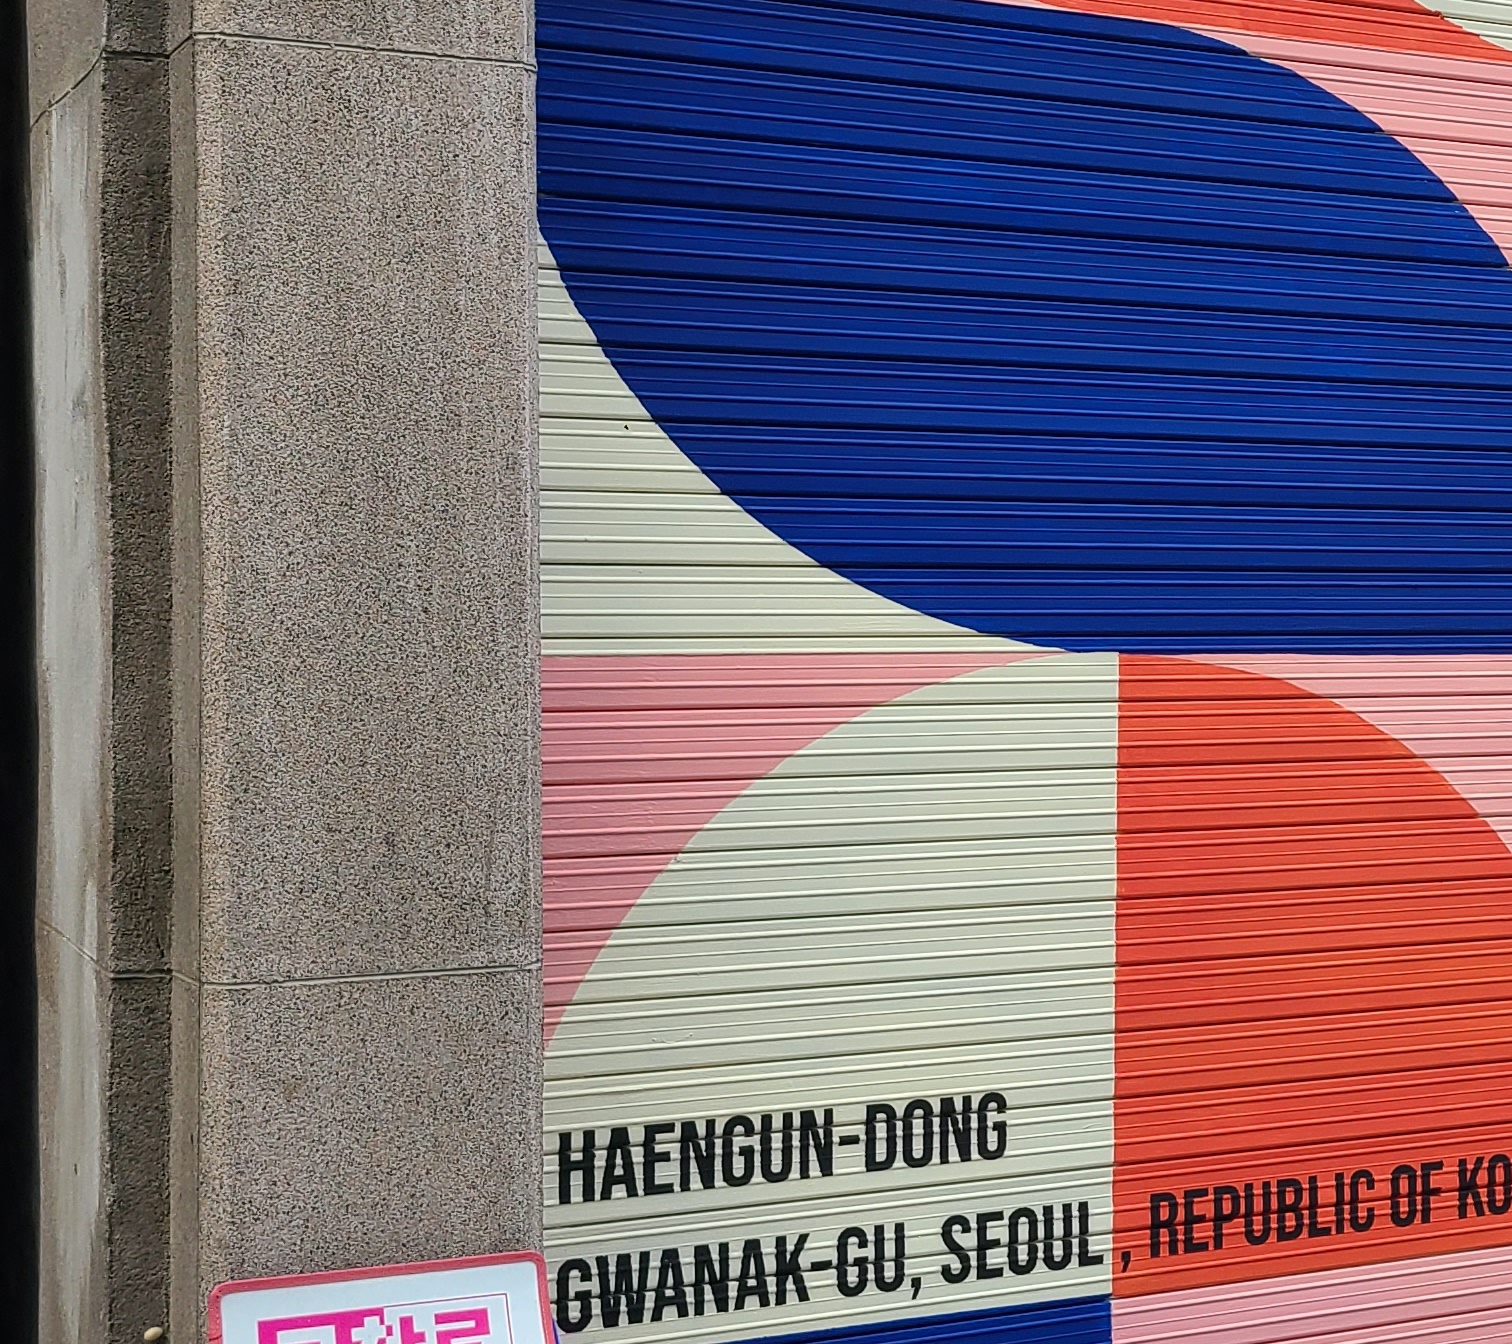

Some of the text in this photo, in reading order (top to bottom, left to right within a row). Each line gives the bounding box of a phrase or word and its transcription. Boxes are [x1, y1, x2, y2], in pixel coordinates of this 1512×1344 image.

[557, 1092, 1008, 1205] HAENGUN-DONG
[556, 1221, 923, 1334] GWANAK-GU,
[1148, 1168, 1376, 1259] REPUBLIC
[1390, 1160, 1444, 1227] OF
